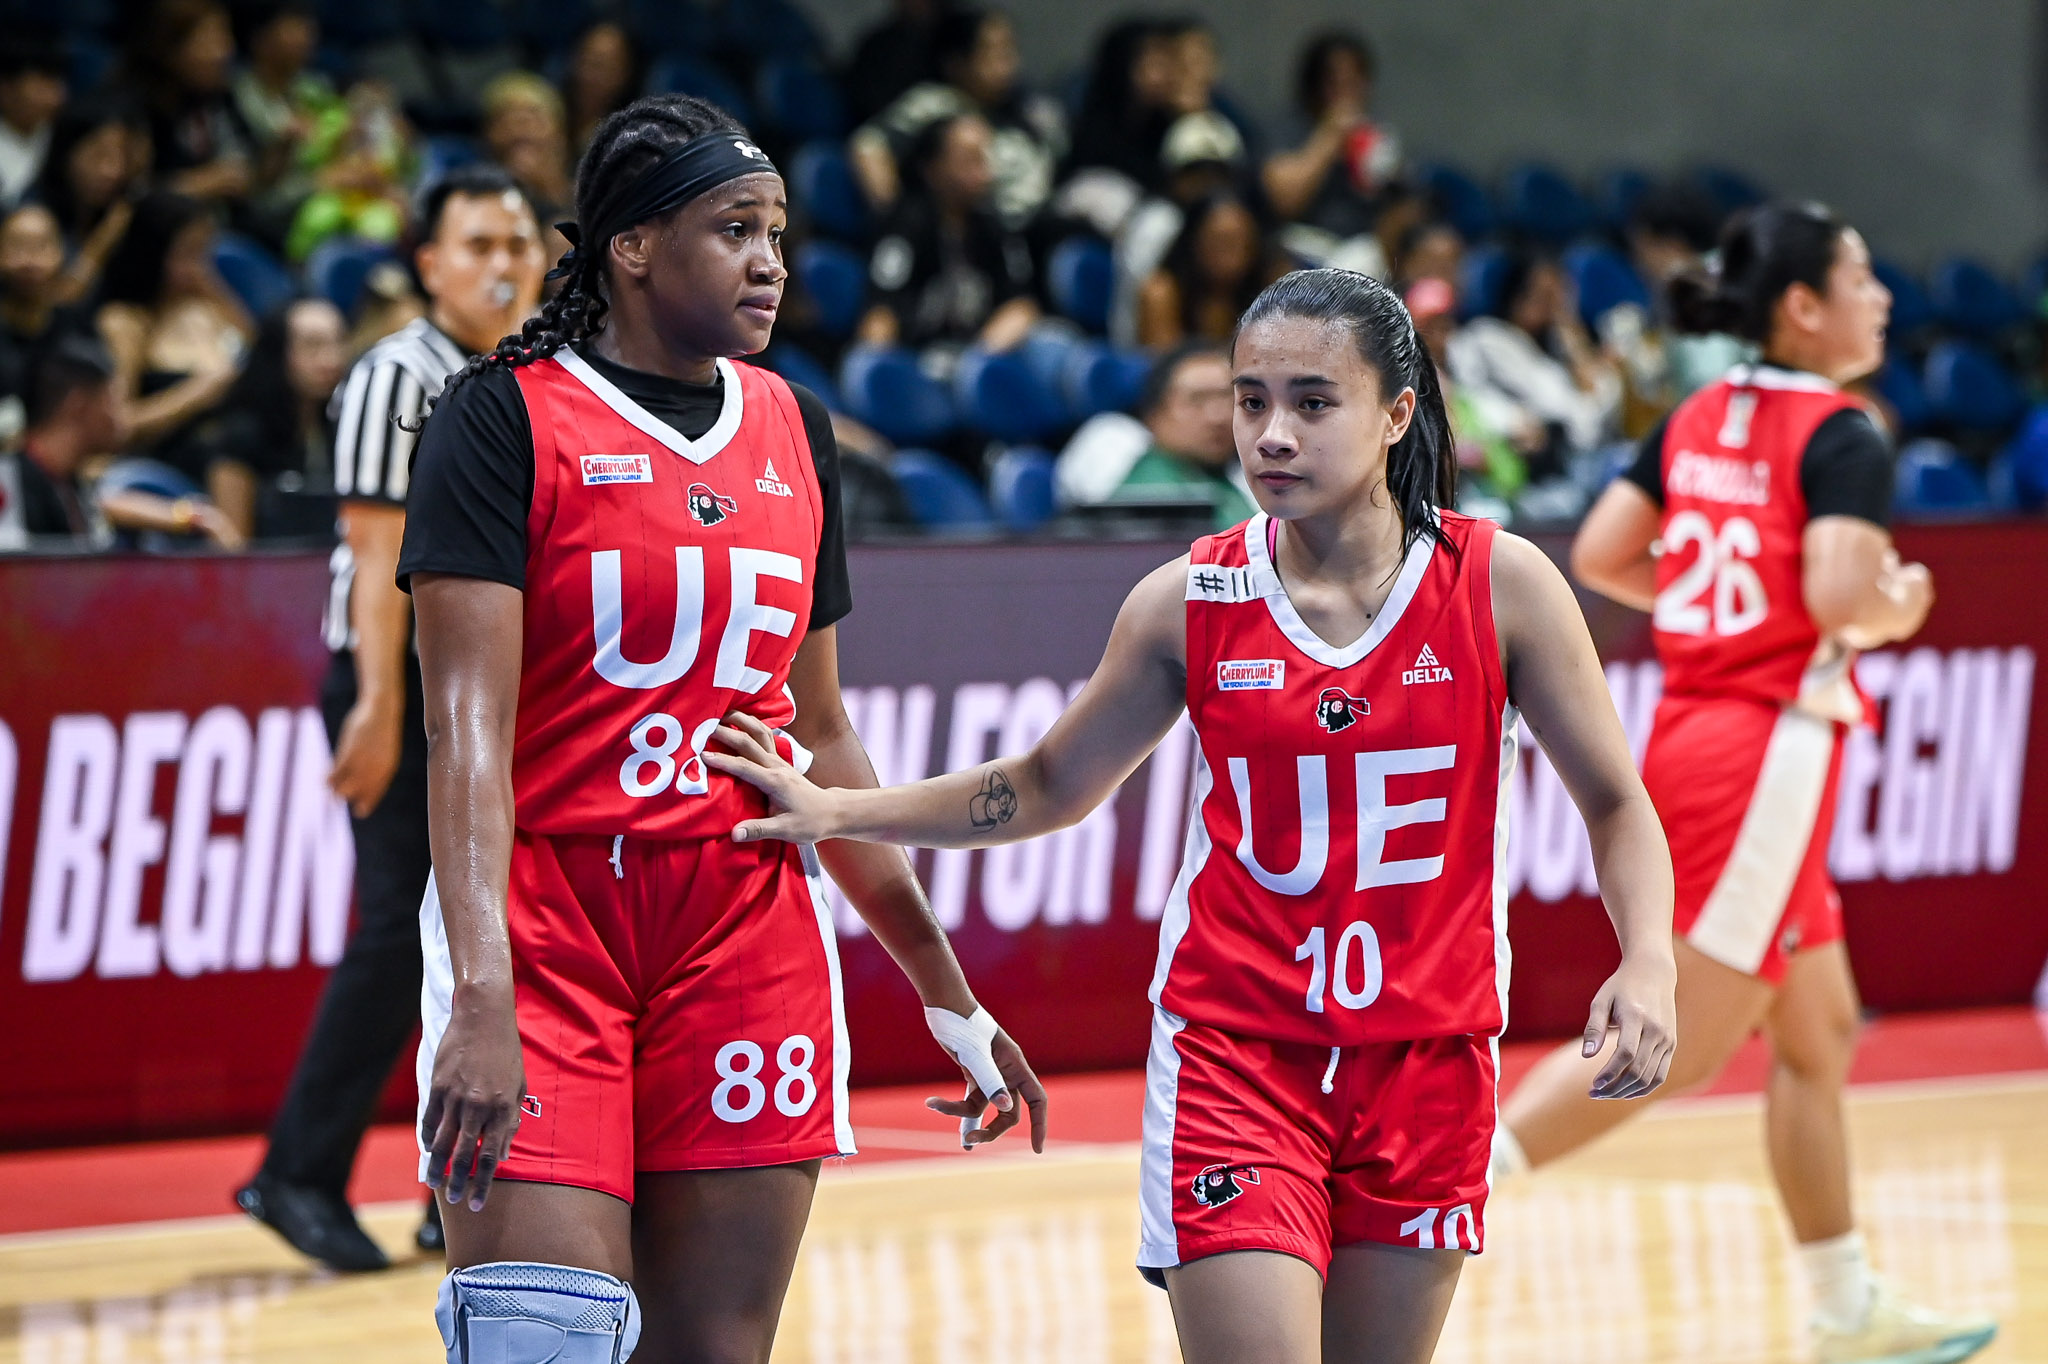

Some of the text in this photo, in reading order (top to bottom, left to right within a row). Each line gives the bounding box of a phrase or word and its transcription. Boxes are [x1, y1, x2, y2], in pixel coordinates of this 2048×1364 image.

[755, 479, 794, 497] DELTA
[591, 546, 803, 695] UE
[1653, 509, 1769, 637] 26
[1402, 667, 1453, 685] DELTA
[1828, 645, 2036, 883] EGIN
[22, 705, 356, 982] BEGIN
[1227, 744, 1457, 896] UE
[1295, 920, 1383, 1013] 10
[711, 1034, 817, 1123] 88
[1399, 1203, 1480, 1250] 10
